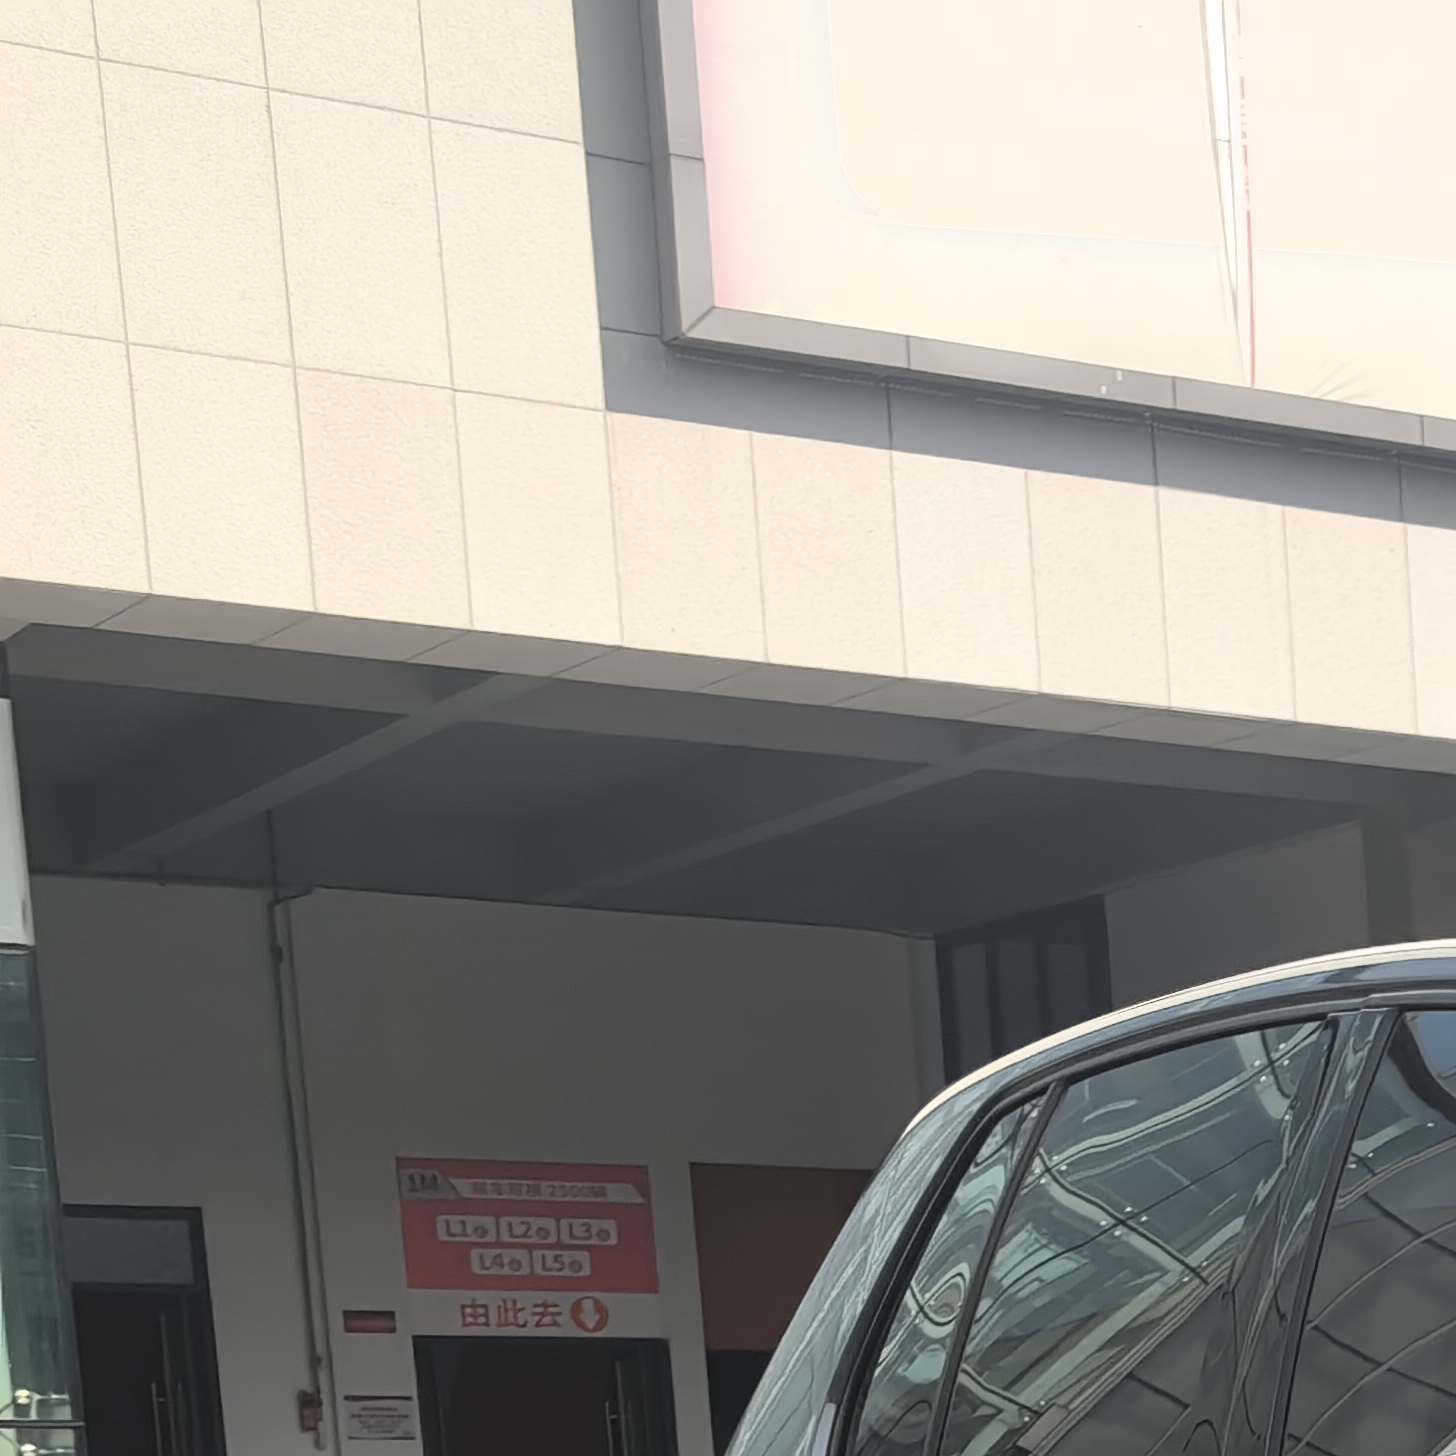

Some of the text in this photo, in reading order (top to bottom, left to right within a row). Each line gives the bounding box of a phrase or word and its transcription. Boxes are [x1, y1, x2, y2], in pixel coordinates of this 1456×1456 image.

[507, 1220, 535, 1241] L2
[568, 1222, 594, 1242] L3
[479, 1253, 506, 1273] L4
[541, 1255, 567, 1274] L5
[461, 1297, 563, 1330] 由此去
